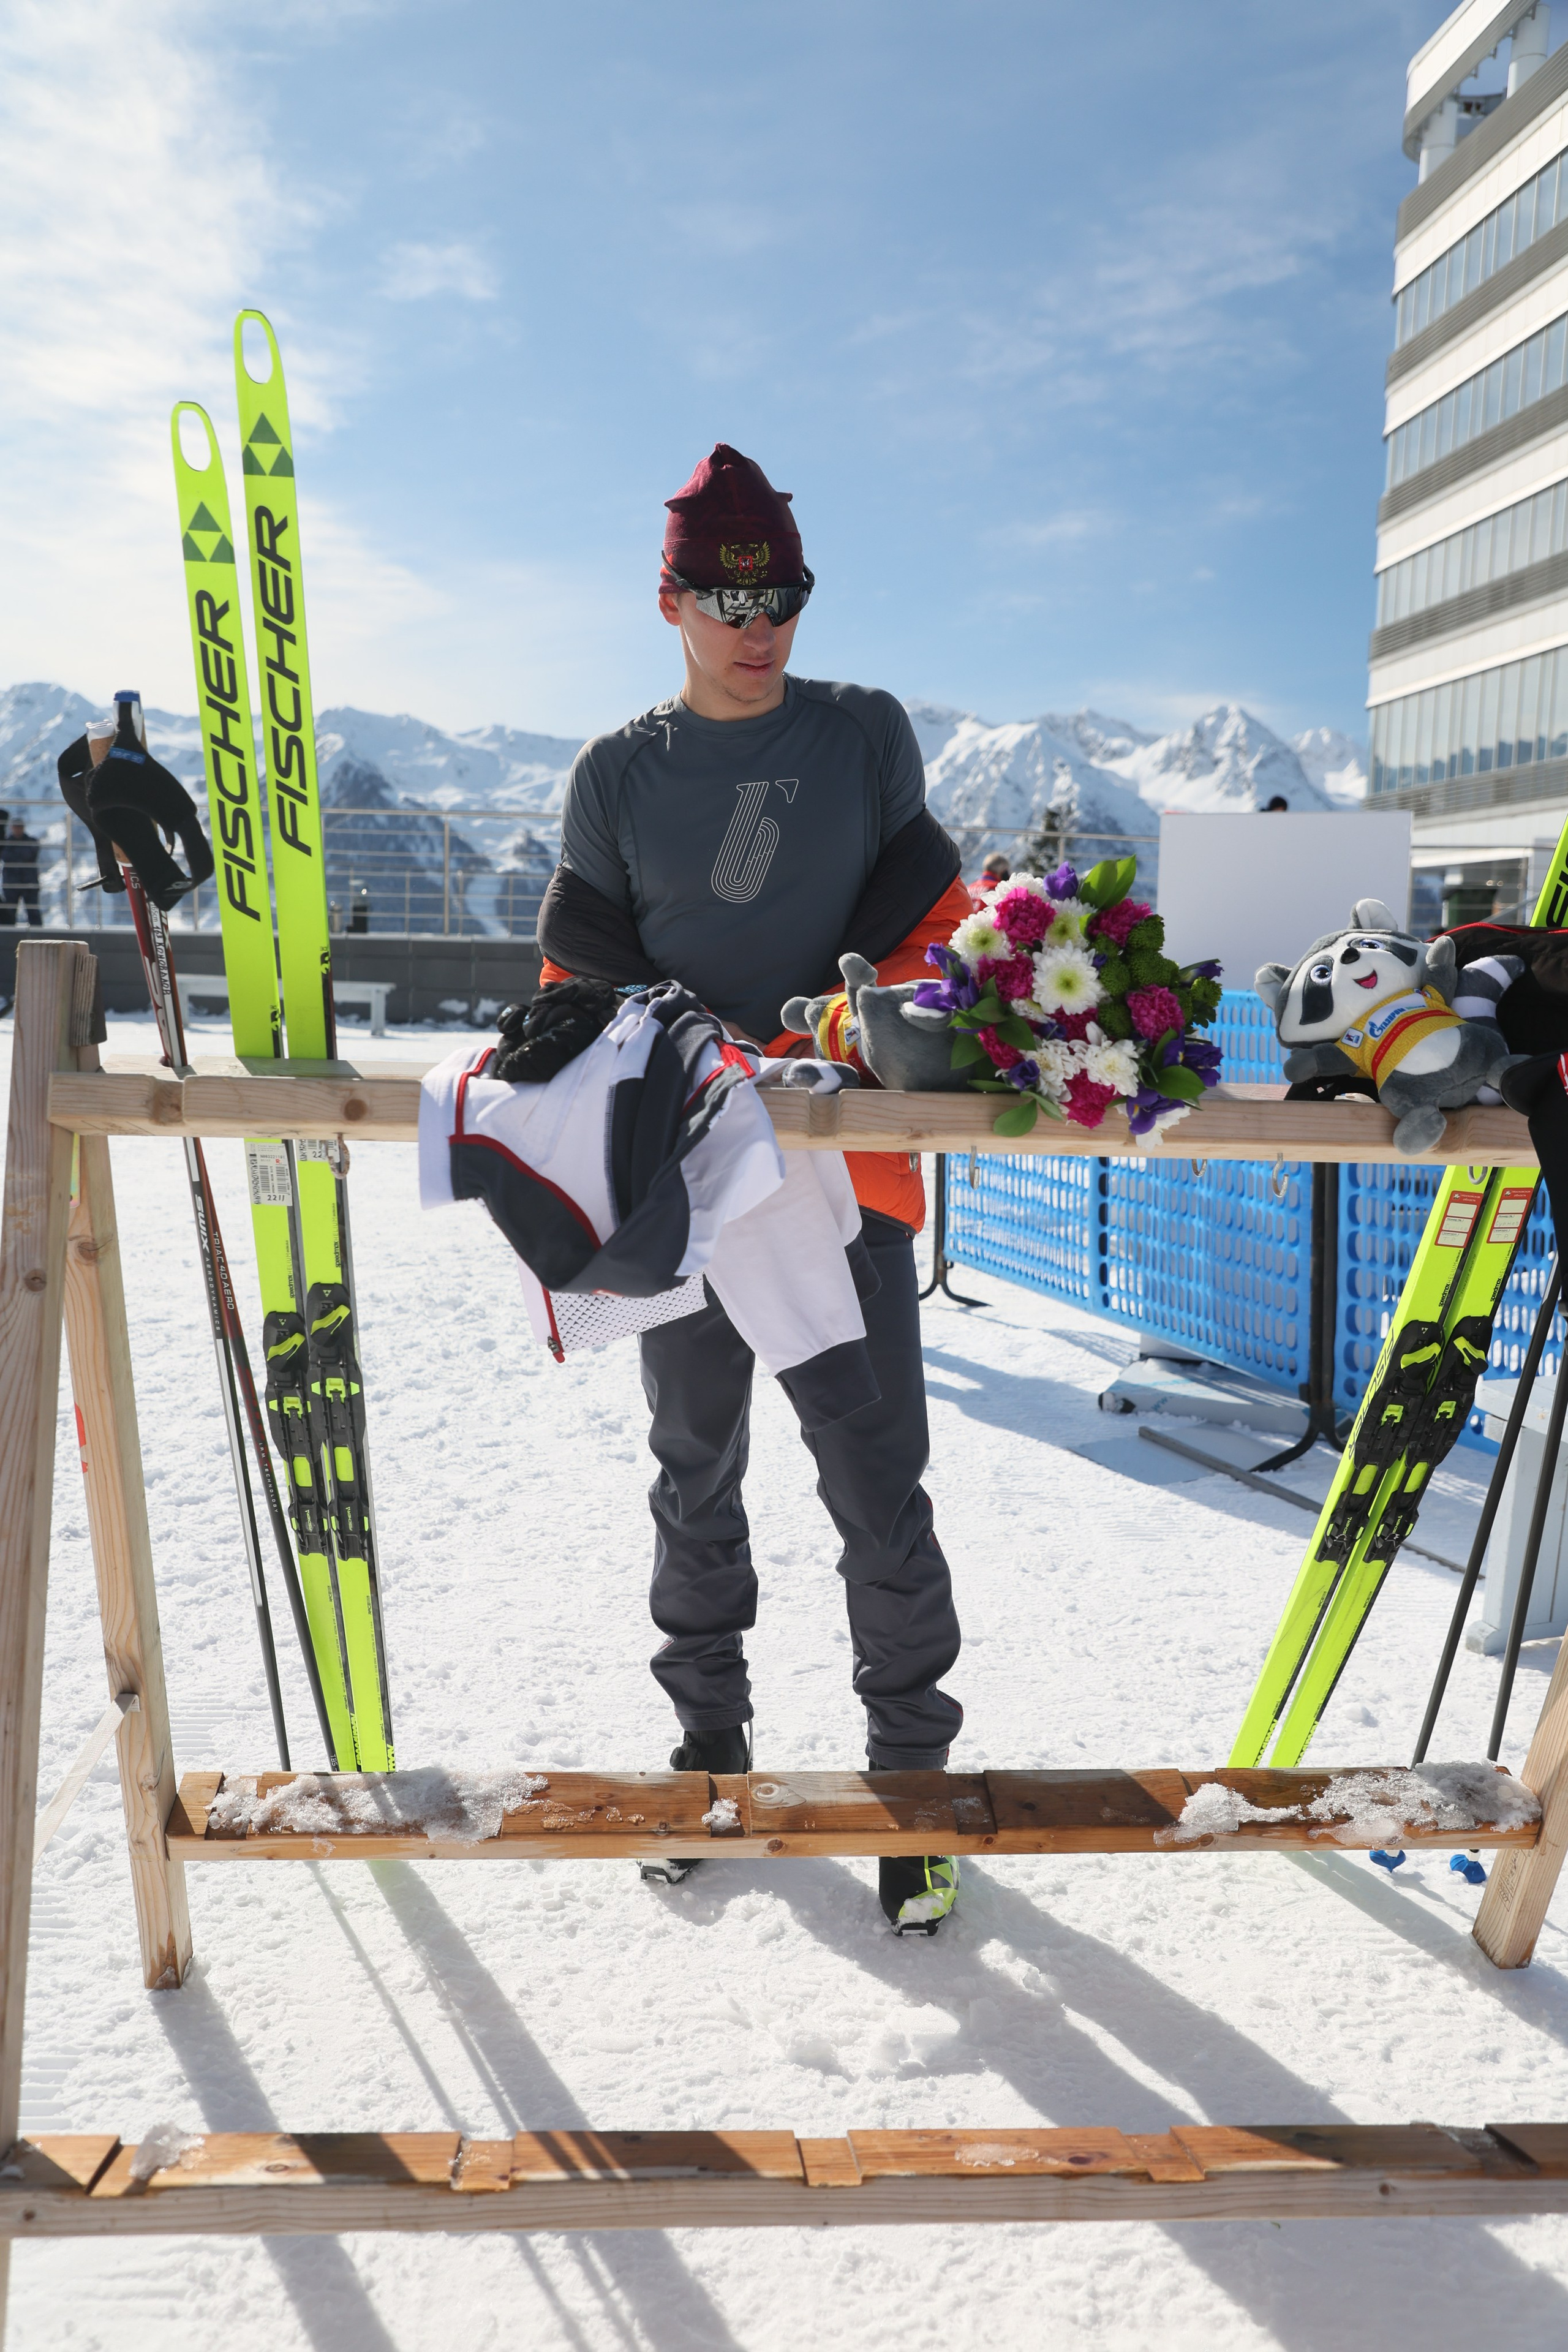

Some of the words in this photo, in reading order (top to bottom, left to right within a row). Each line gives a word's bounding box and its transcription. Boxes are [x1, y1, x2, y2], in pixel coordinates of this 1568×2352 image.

[255, 505, 312, 858] FISCHER
[195, 589, 260, 922] FISCHER
[1381, 1007, 1406, 1031] ГАЗПРОМ
[194, 1194, 209, 1254] SWIX
[205, 1257, 221, 1331] AERODYNAMICS
[213, 1231, 224, 1264] TRIAC
[222, 1280, 235, 1310] AERO
[1438, 1283, 1450, 1307] speedmax
[1447, 1262, 1459, 1284] HELIUM
[1490, 1278, 1502, 1302] speedmax
[1498, 1256, 1510, 1278] HELIUM
[263, 1463, 279, 1513] TECHNOLOGY
